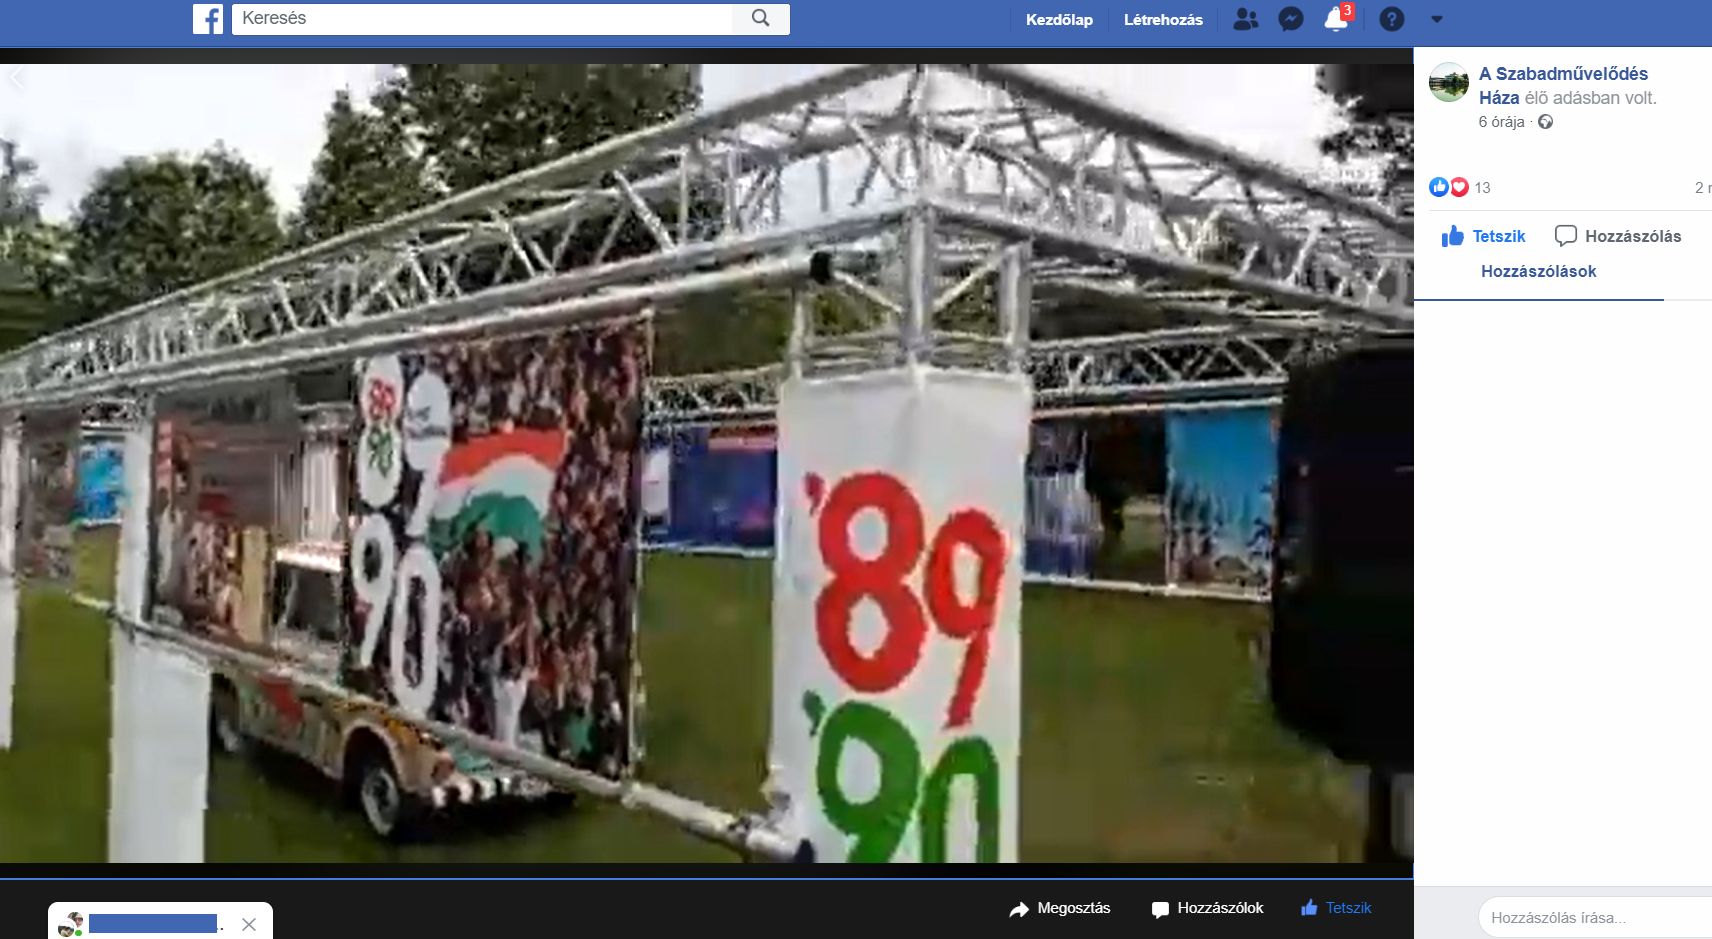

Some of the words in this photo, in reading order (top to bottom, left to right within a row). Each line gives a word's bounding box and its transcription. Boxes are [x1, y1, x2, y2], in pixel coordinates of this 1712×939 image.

[1343, 4, 1352, 16] 3
[242, 10, 307, 25] Keresés
[1026, 13, 1094, 29] Kezdőlap
[1124, 13, 1204, 27] Létrehozás
[1478, 66, 1493, 81] A
[1495, 65, 1649, 81] Szabadművelődés
[1479, 89, 1520, 105] Háza
[1524, 90, 1549, 105] élő
[1552, 90, 1620, 105] adásban
[1624, 90, 1657, 105] volt.
[1478, 115, 1488, 128] 6
[1491, 115, 1525, 131] órája
[1474, 181, 1491, 194] 13
[1695, 181, 1704, 194] 2
[1472, 229, 1527, 243] Tetszik
[1585, 229, 1682, 243] Hozzászólás
[1481, 264, 1598, 278] Hozzászólások
[1037, 901, 1112, 917] Megosztás
[1177, 901, 1265, 915] Hozzászólok
[1325, 901, 1372, 915] Tetszik
[1491, 911, 1577, 925] Hozzászólás
[1580, 911, 1627, 925] írása...
